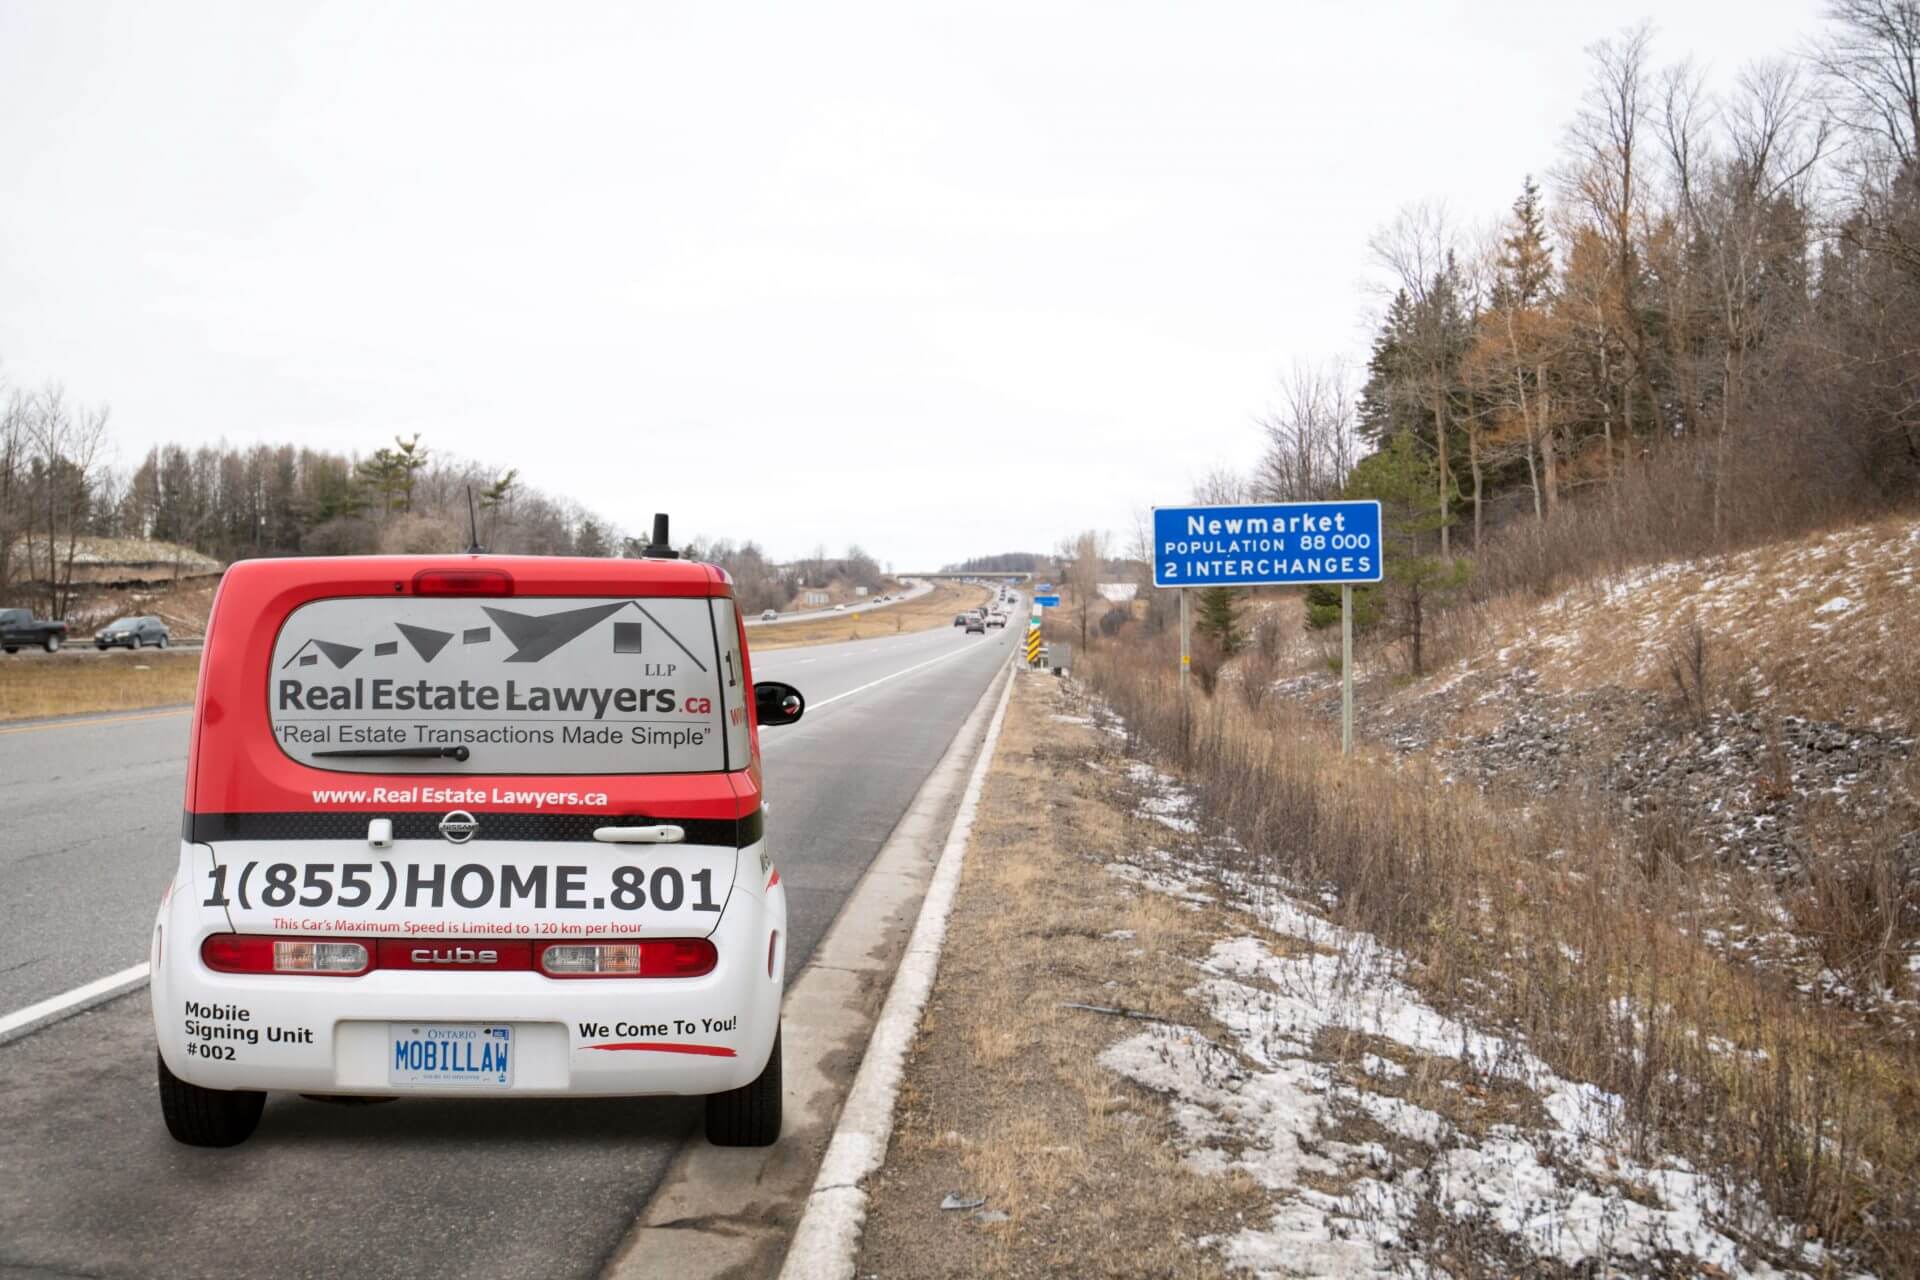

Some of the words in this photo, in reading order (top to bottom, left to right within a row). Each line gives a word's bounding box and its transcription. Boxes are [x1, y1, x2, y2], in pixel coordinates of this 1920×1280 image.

[1187, 512, 1346, 537] Newmarket
[1165, 538, 1285, 556] POPULATION
[1300, 535, 1326, 551] 88
[1331, 534, 1371, 550] 000
[1164, 562, 1178, 578] 2
[1186, 556, 1372, 577] INTERCHANGES
[645, 663, 676, 677] LLP
[339, 725, 407, 744] Estate
[413, 725, 554, 744] Transactions
[562, 726, 623, 745] Made
[273, 918, 298, 930] This
[335, 920, 400, 932] Maximum
[404, 921, 445, 935] Speed
[449, 921, 459, 933] is
[462, 922, 512, 934] Limited
[517, 924, 530, 934] to
[534, 923, 557, 934] 120
[561, 923, 581, 934] km
[585, 924, 607, 936] per
[611, 922, 642, 934] hour
[411, 947, 498, 963] cube
[185, 1020, 259, 1045] Signing
[267, 1026, 314, 1044] Unit
[579, 1023, 609, 1038] We
[615, 1022, 668, 1037] Come
[673, 1020, 696, 1035] To
[702, 1016, 737, 1033] You!
[187, 1042, 237, 1061] #002
[395, 1039, 508, 1072] MOBILLAW
